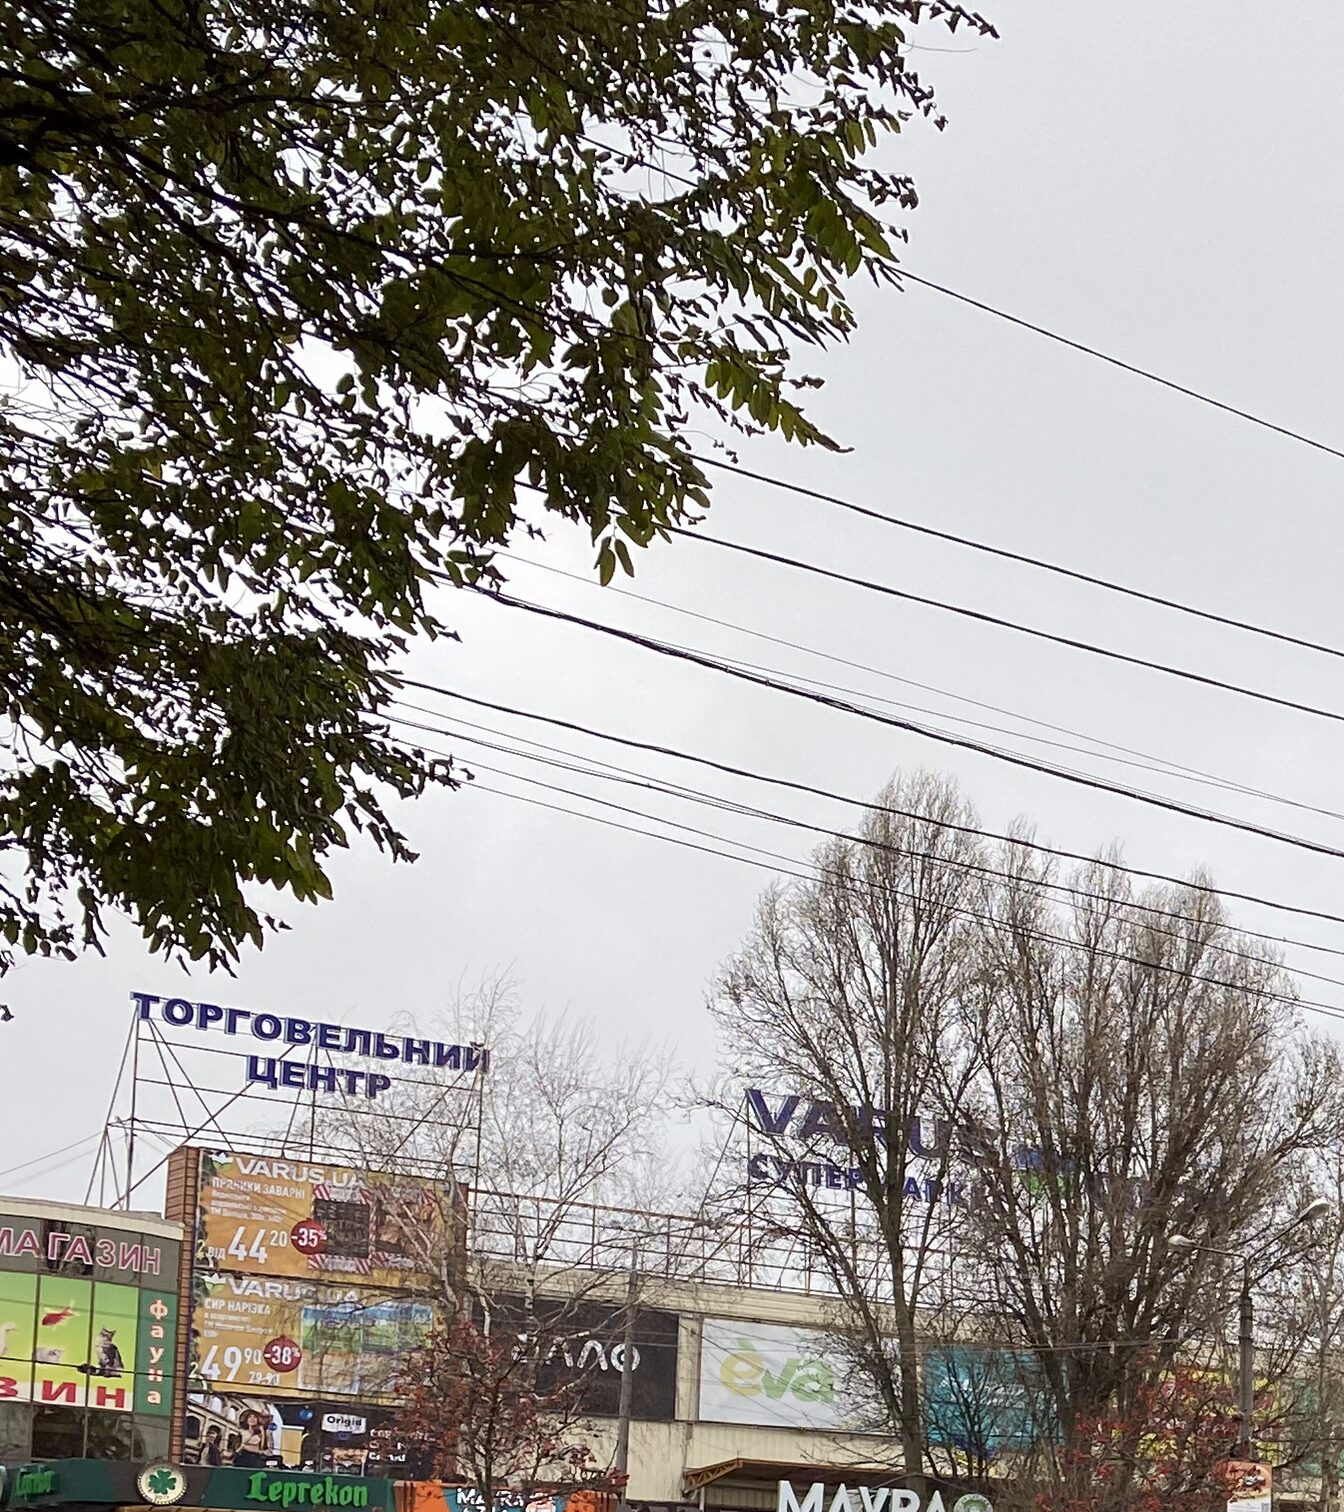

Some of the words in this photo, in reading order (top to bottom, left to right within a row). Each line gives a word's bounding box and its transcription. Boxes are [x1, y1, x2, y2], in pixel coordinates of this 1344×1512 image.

[130, 992, 491, 1073] ТОРГОВЕЛЬНИЙ
[246, 1055, 392, 1100] ЦЕНТР
[228, 1226, 268, 1265] 44
[270, 1230, 288, 1247] 20
[200, 1345, 242, 1383] 49
[244, 1348, 261, 1365] 90
[247, 1471, 368, 1508] Leprekon
